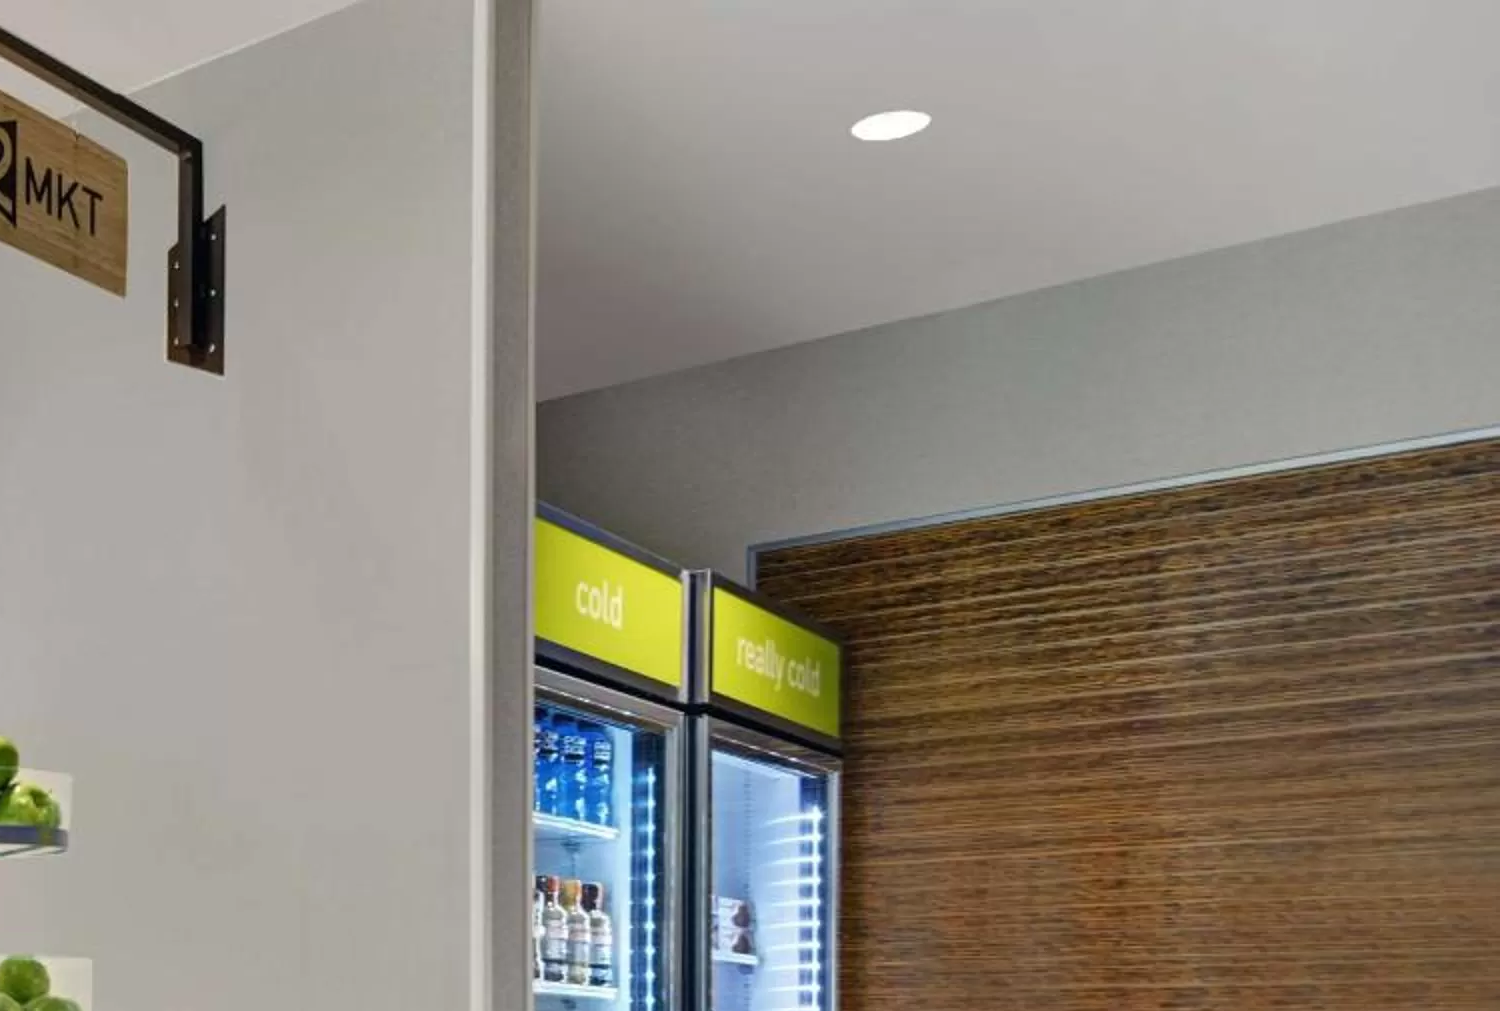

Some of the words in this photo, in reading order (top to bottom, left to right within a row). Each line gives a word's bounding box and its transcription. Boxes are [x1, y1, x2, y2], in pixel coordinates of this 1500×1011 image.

[25, 156, 104, 237] MKT
[575, 579, 623, 630] cold
[736, 636, 786, 691] really
[787, 656, 821, 697] cold
